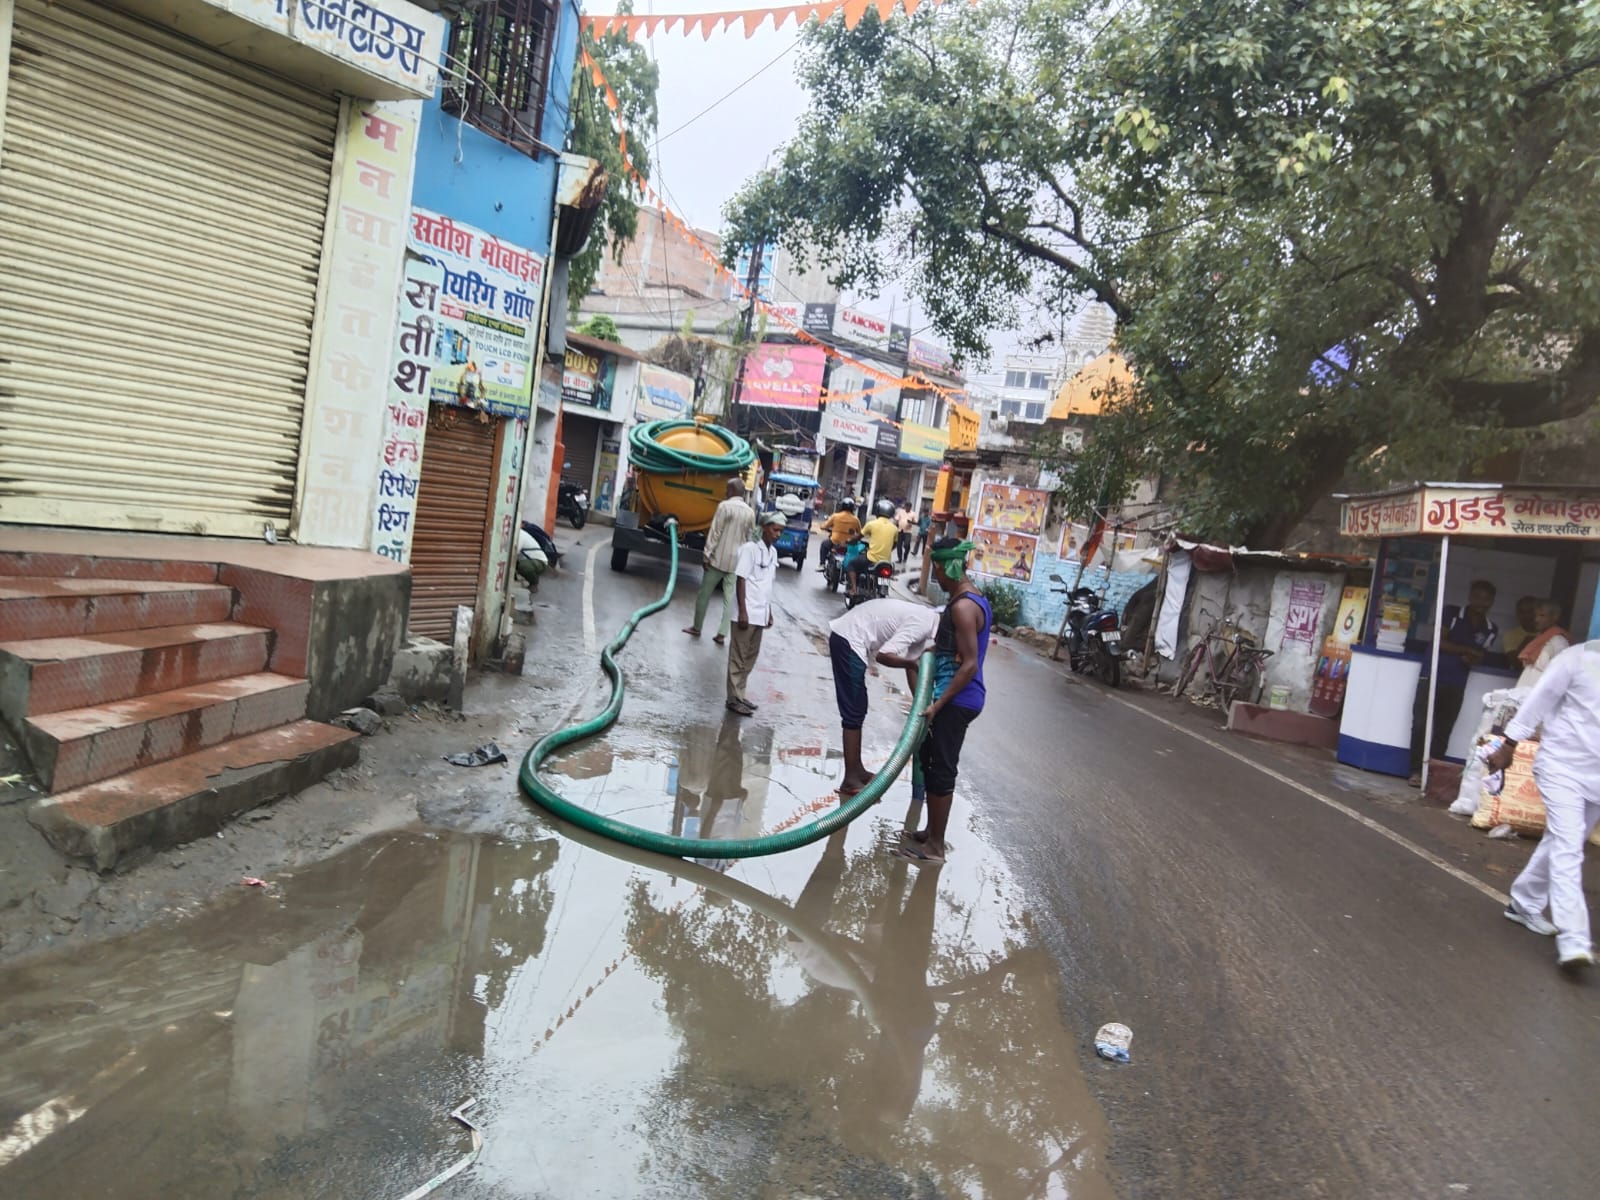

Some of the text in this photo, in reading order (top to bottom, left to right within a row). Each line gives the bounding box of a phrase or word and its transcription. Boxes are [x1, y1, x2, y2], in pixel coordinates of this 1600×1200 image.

[411, 212, 474, 258] सतीश
[503, 287, 536, 323] शॉप
[394, 277, 439, 395] सतीश
[850, 314, 886, 334] ANCHOR
[475, 341, 498, 355] TOUCH
[499, 349, 512, 359] LCD
[839, 421, 869, 434] ANCHOR
[1287, 605, 1320, 631] SPY
